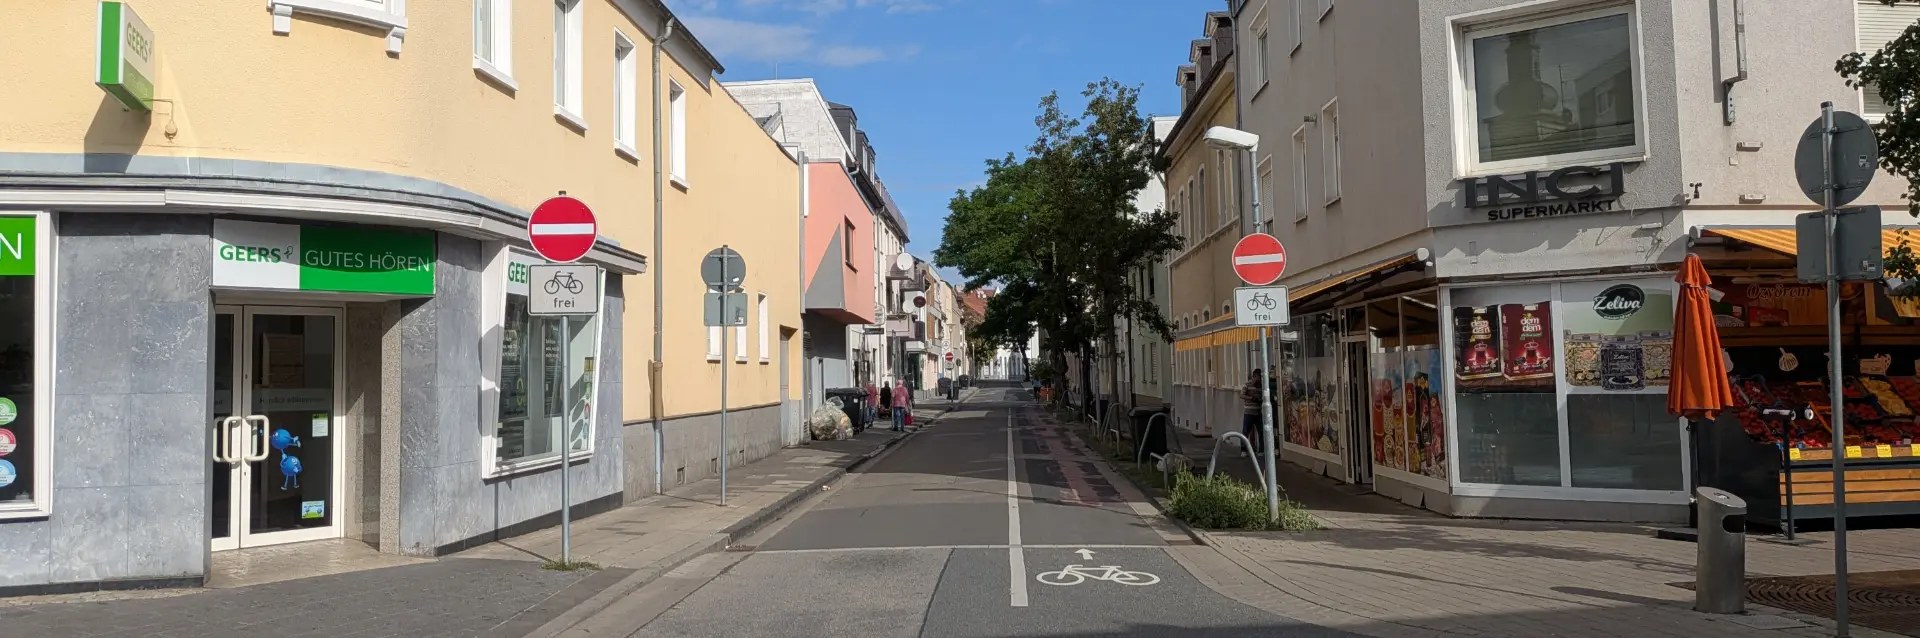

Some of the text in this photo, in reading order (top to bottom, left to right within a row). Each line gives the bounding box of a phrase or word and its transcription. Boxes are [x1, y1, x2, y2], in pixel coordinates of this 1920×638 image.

[126, 21, 149, 63] GEERS
[1464, 162, 1626, 208] INCI
[1487, 199, 1614, 221] SUPERMARKT
[219, 245, 282, 262] GEERS
[305, 250, 430, 272] GUTES HÖREN
[553, 297, 575, 308] frei
[1593, 295, 1642, 310] Zeliva
[1254, 312, 1271, 321] frei
